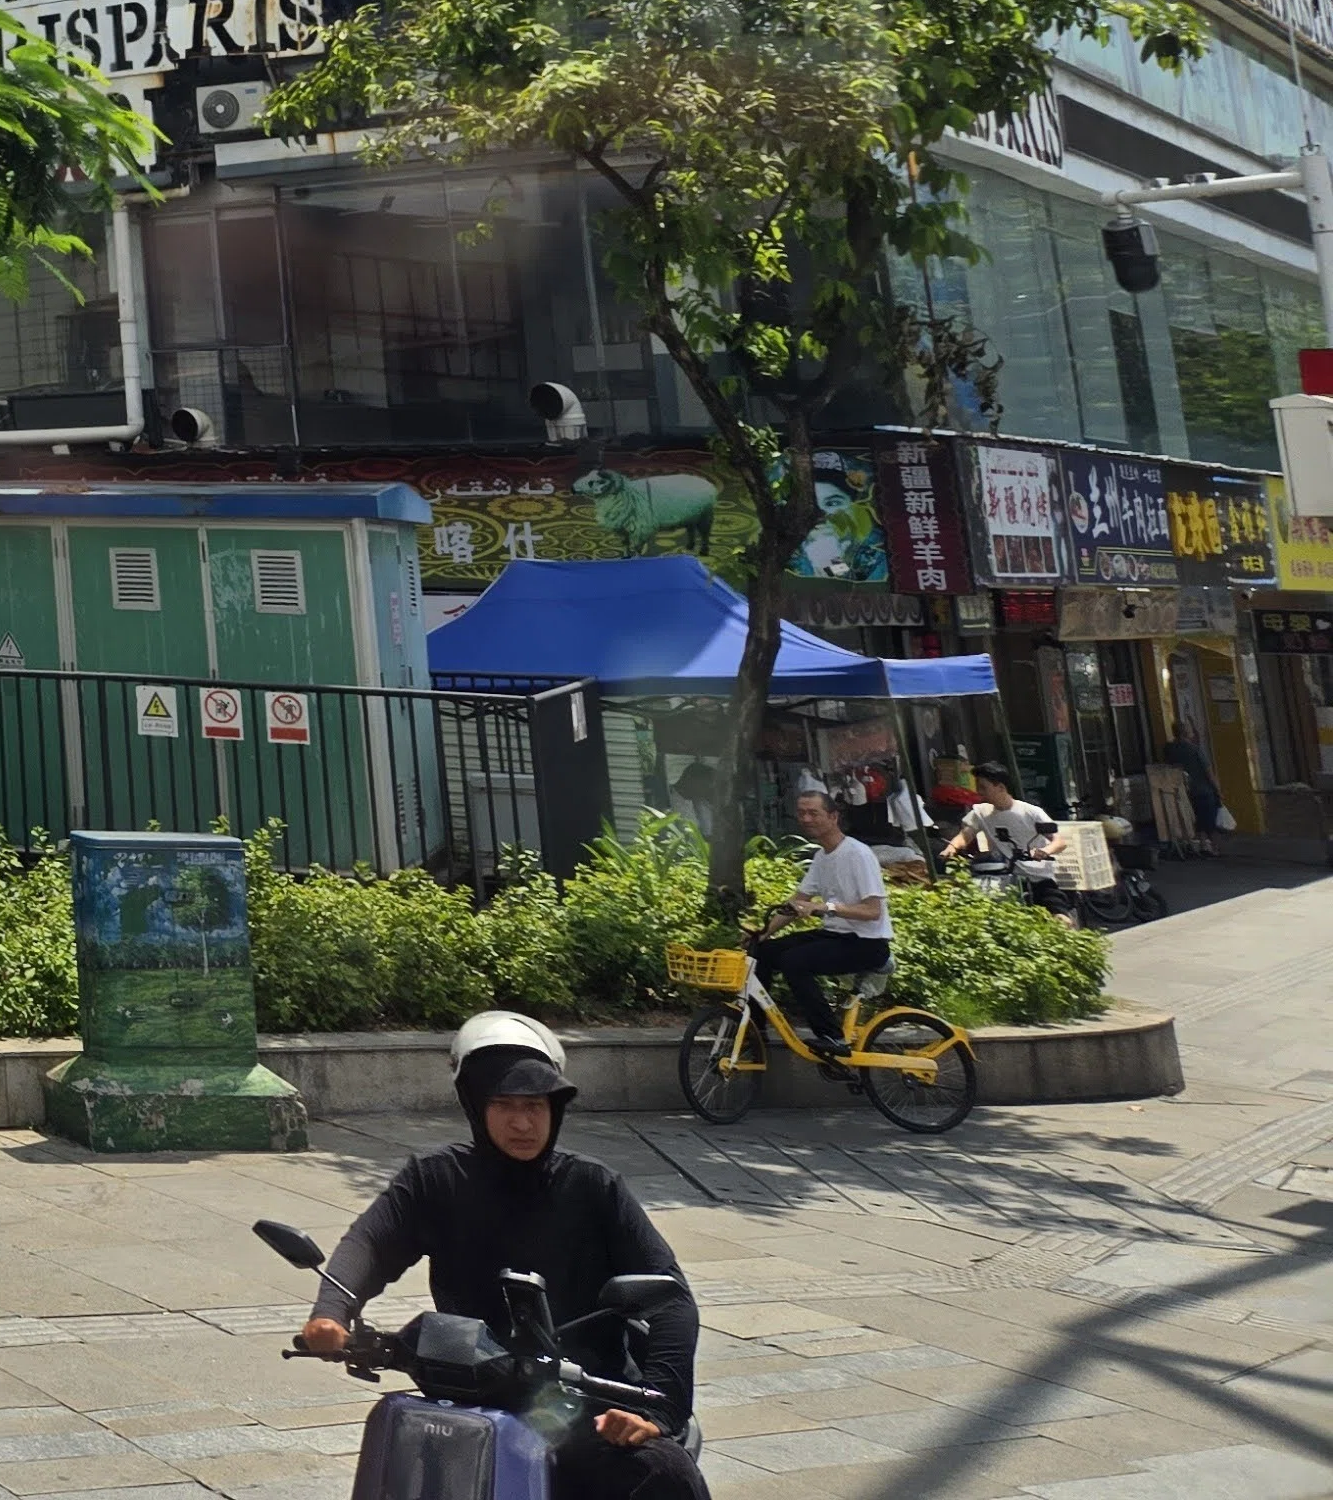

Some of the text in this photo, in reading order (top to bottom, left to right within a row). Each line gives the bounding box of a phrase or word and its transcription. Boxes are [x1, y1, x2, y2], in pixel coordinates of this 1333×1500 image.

[433, 521, 544, 564] 喀什
[895, 441, 947, 591] 新疆新鲜羊肉
[1088, 463, 1170, 546] 兰州牛肉拉面
